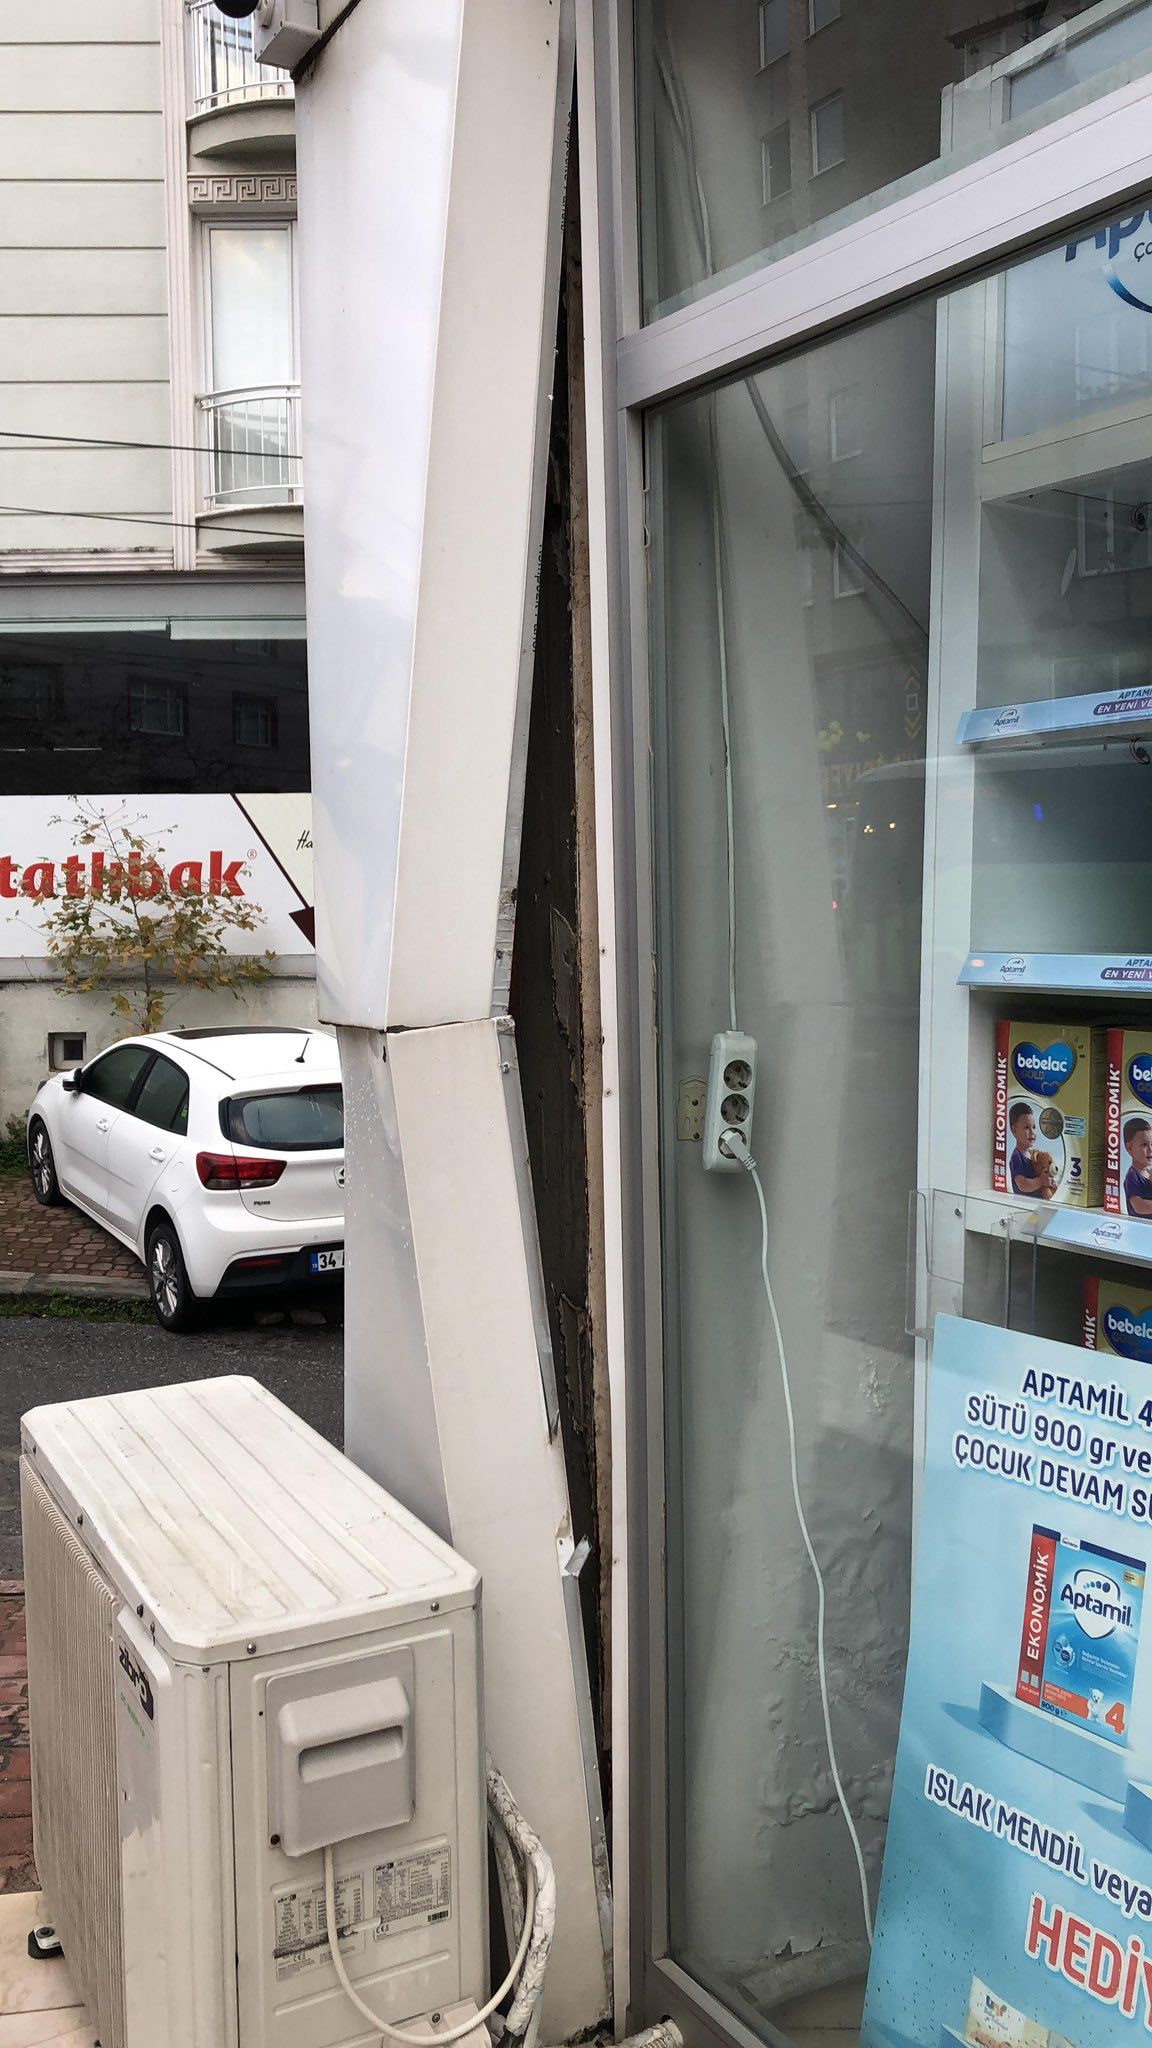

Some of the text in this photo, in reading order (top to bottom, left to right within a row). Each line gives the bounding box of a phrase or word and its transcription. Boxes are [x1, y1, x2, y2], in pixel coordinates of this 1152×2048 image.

[1097, 705, 1111, 713] EN
[1118, 688, 1152, 699] APTAM
[1104, 969, 1147, 979] EN YENİ
[1017, 1052, 1067, 1073] bebelac
[1132, 1064, 1152, 1082] be
[995, 1056, 1007, 1151] EKONOMİK
[1106, 1068, 1120, 1170] EKONOMİK
[1070, 1156, 1082, 1177] 3
[319, 1253, 336, 1269] 34
[1022, 1369, 1152, 1427] APTAMİL 4
[967, 1394, 1152, 1473] SÜTÜ 900 gr ve
[955, 1434, 1152, 1520] ÇOCUK DEVAM S
[1027, 1551, 1049, 1660] EKONOMİK
[1061, 1584, 1131, 1626] Aptamil
[1041, 1701, 1055, 1712] 900
[1105, 1702, 1126, 1735] 4
[928, 1768, 1152, 1917] ISLAK MENDİL veya
